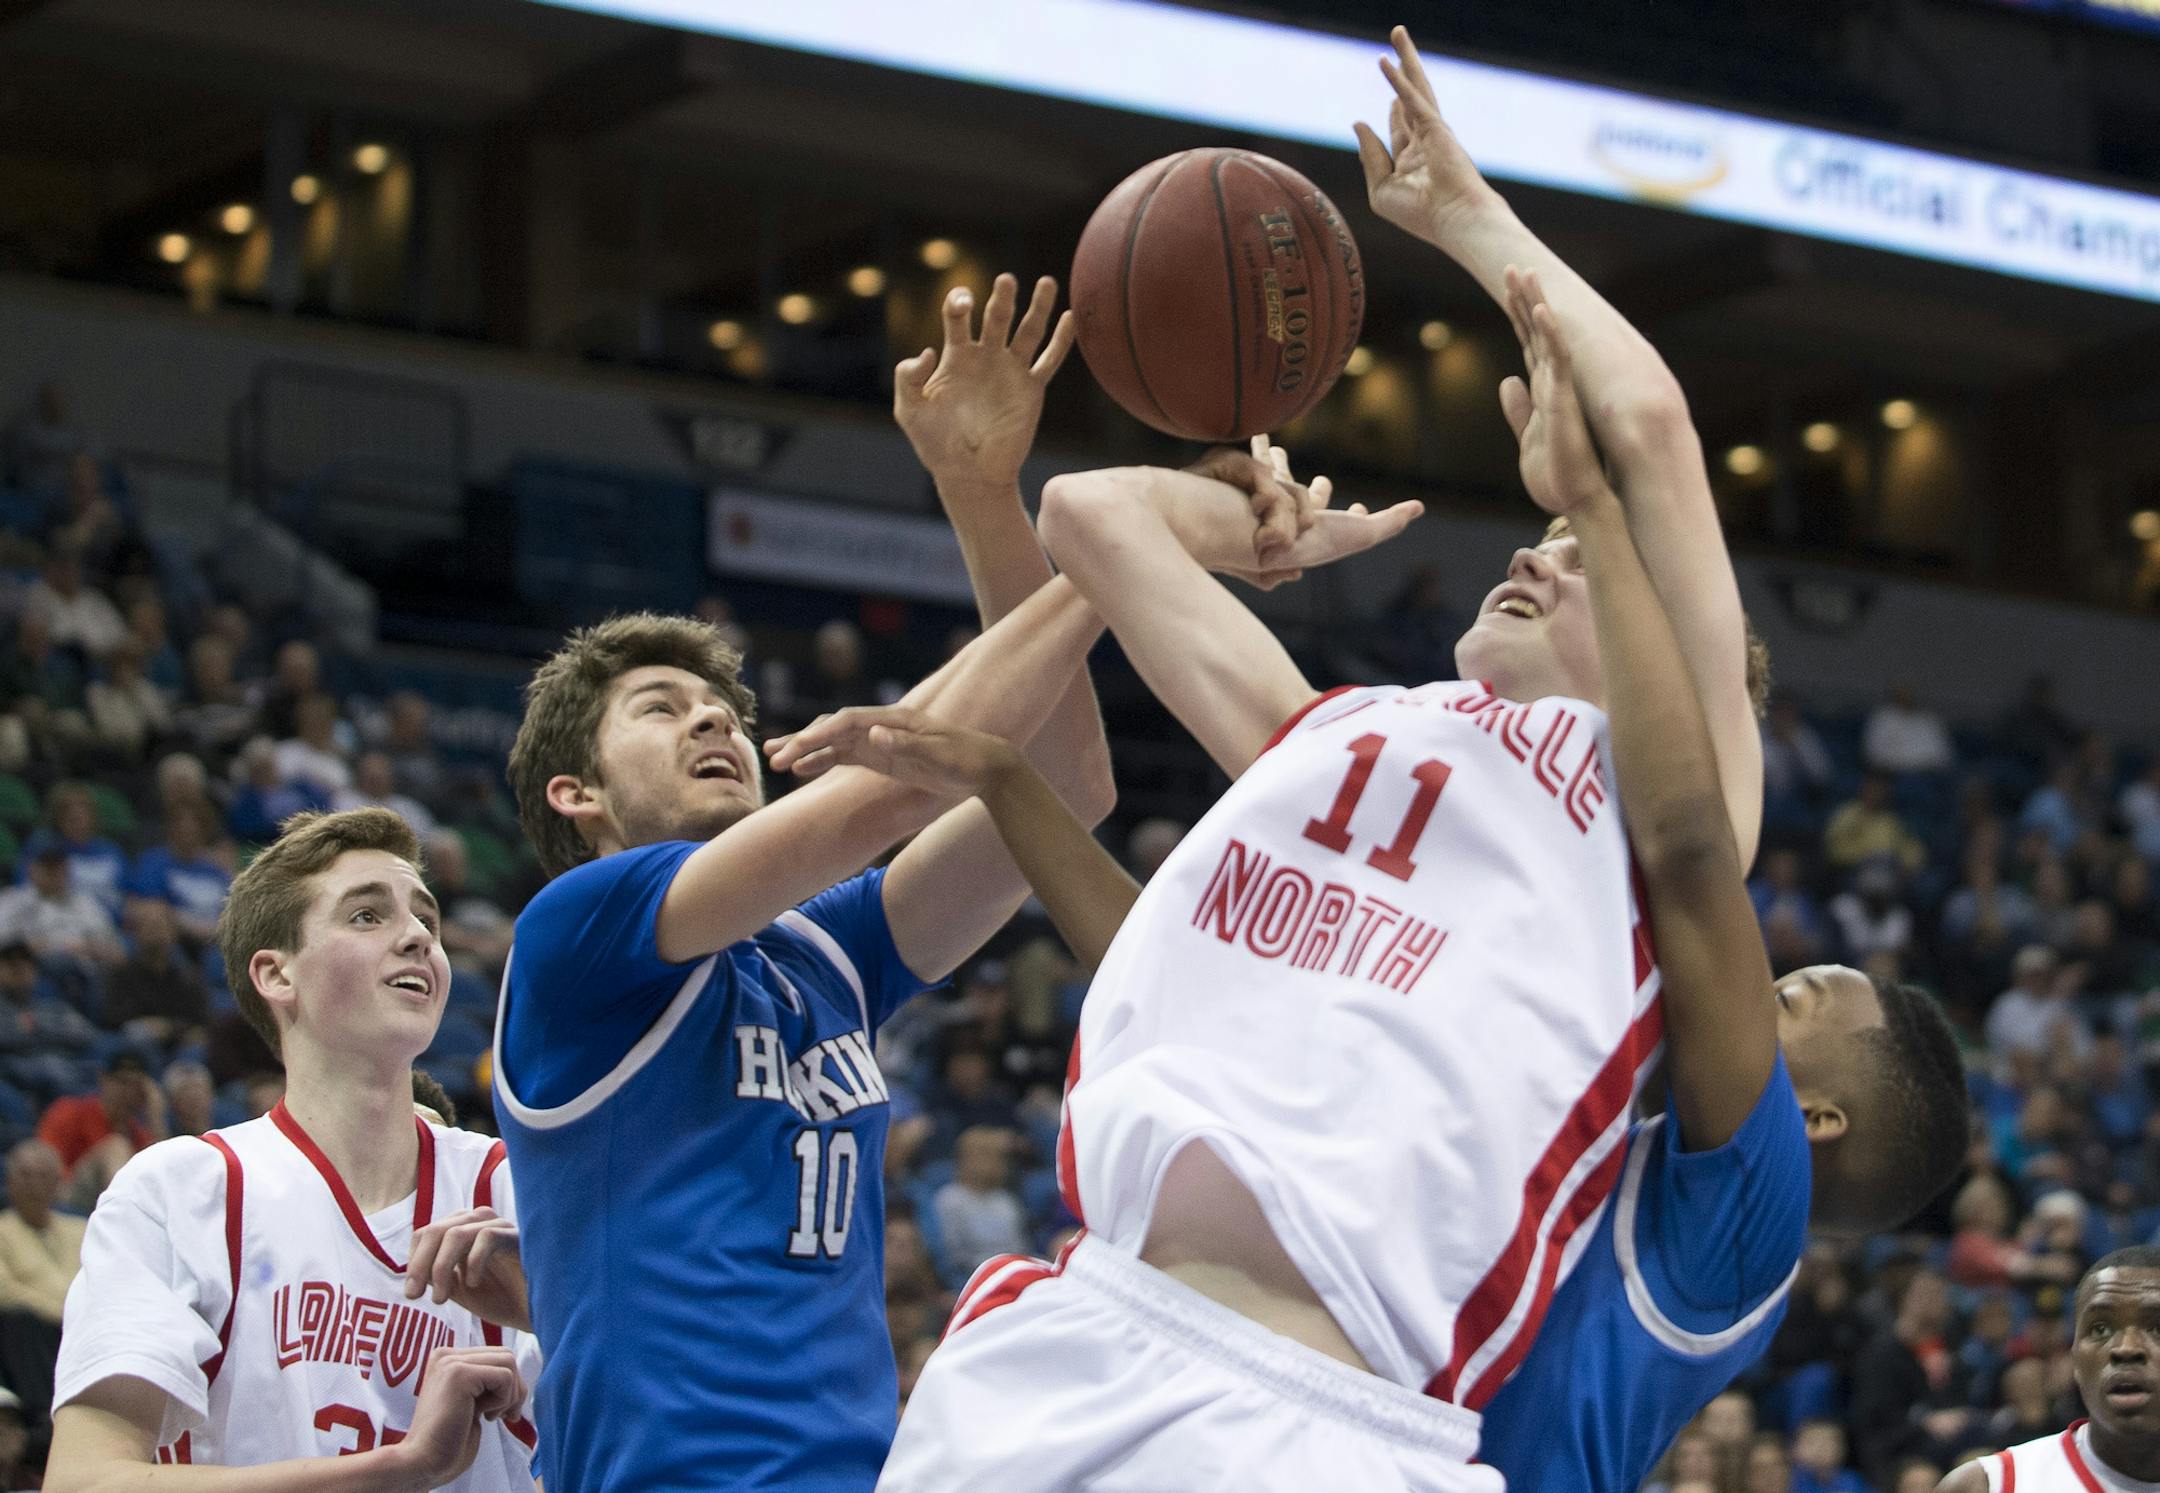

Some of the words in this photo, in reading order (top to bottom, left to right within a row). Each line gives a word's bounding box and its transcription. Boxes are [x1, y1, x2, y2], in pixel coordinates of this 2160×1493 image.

[1774, 134, 1960, 229] Official
[1302, 731, 1453, 882] 11
[1190, 838, 1449, 996] NORTH
[734, 1024, 890, 1123] HKIN
[786, 1128, 858, 1258] 10
